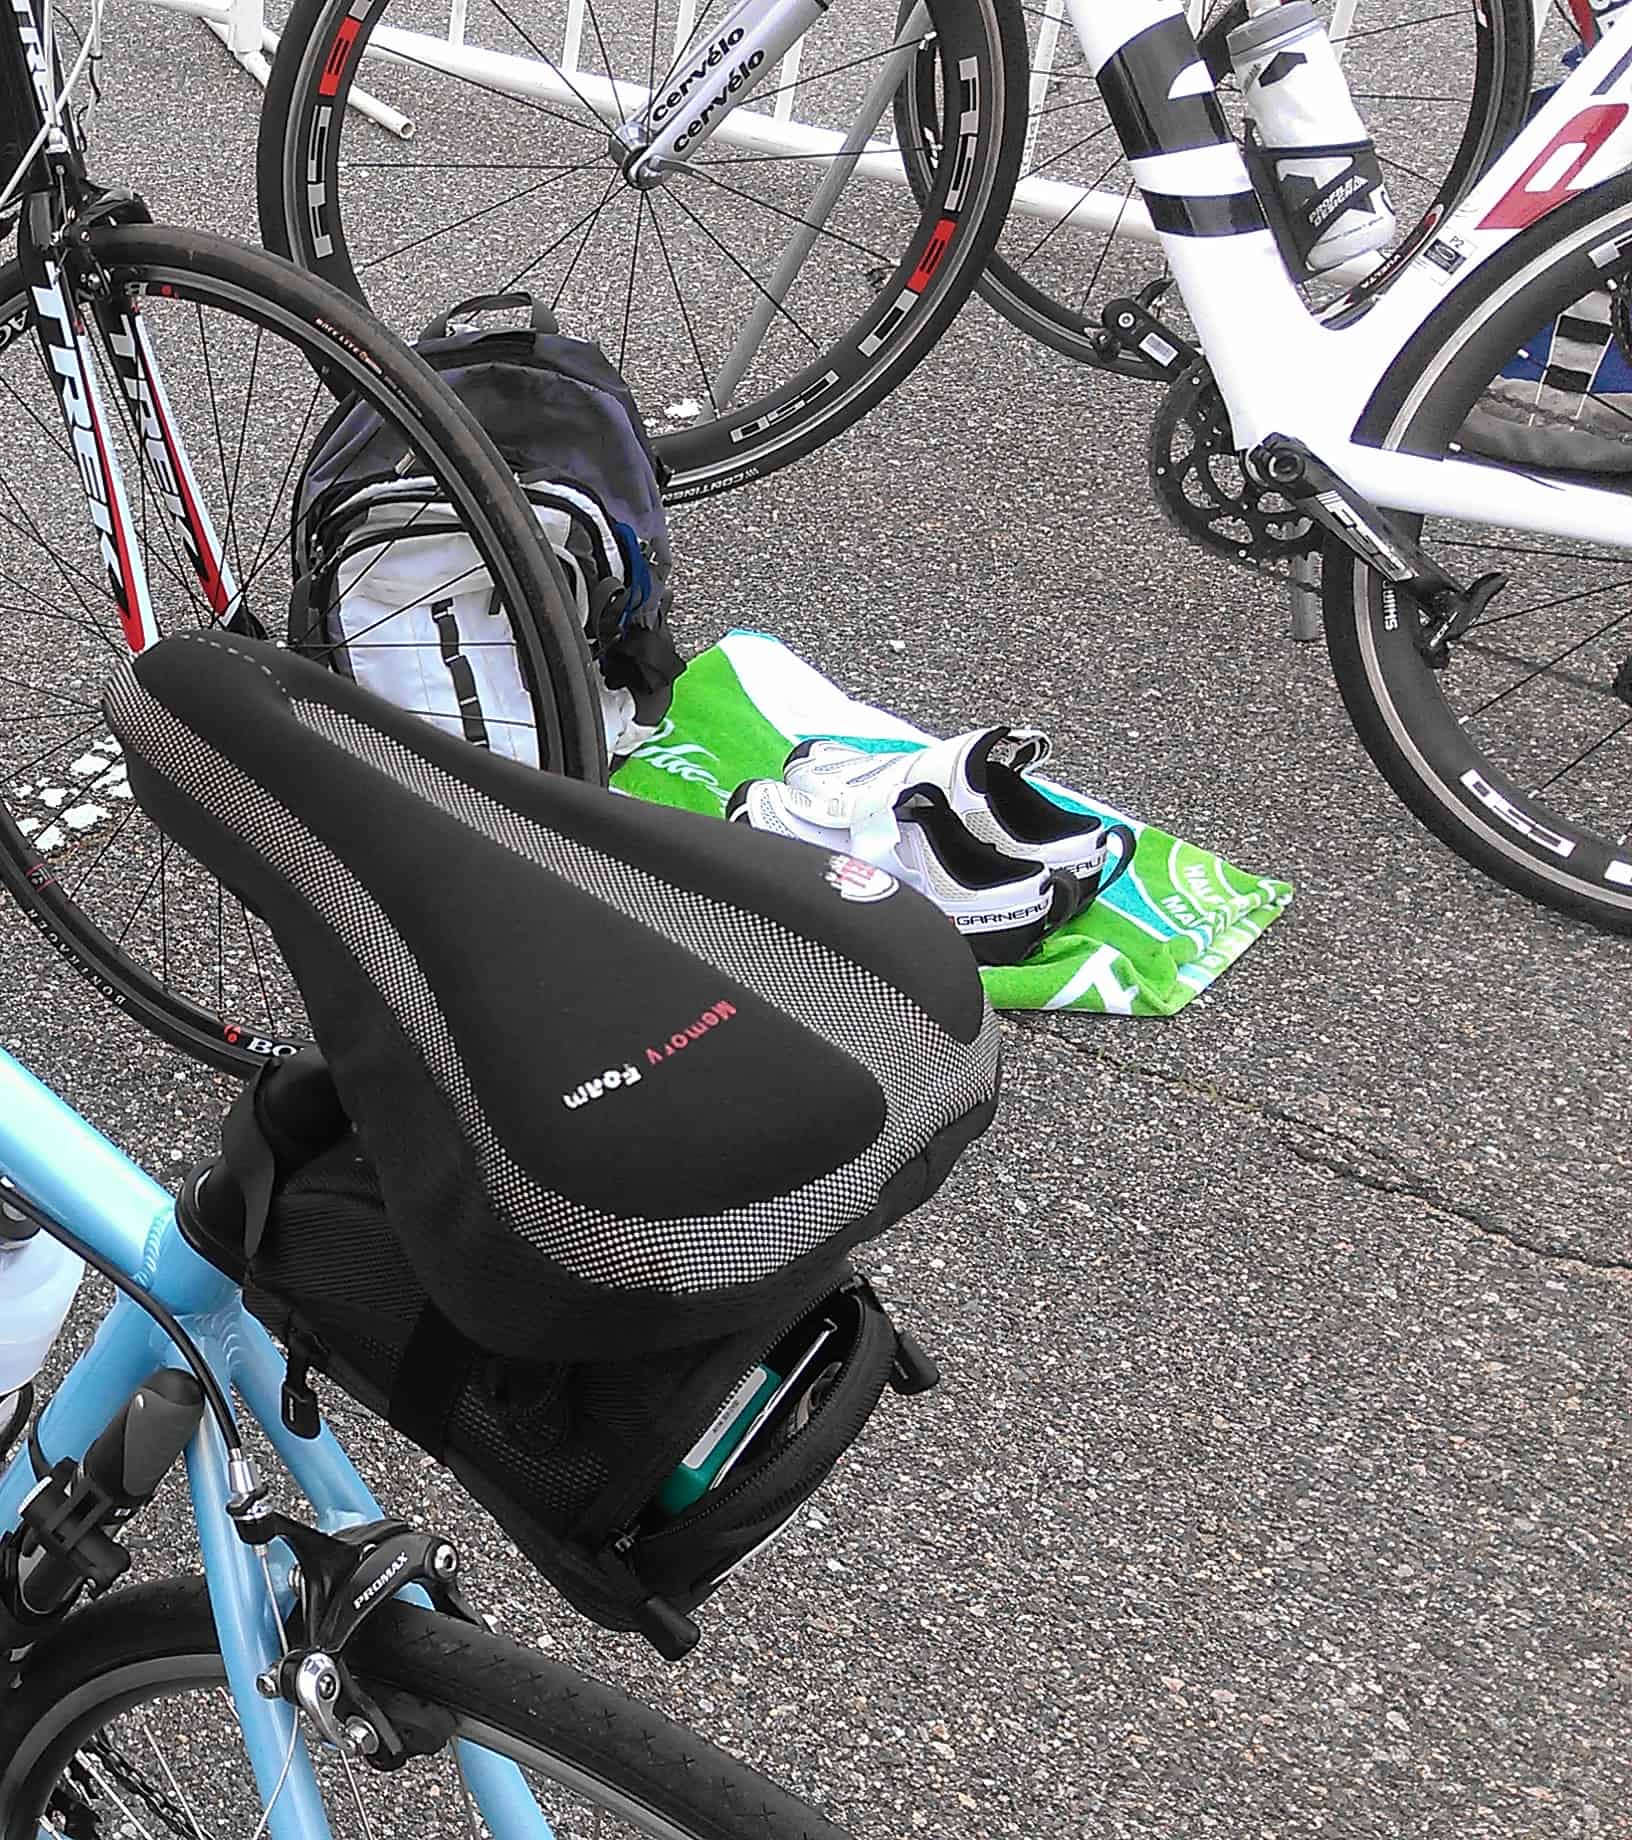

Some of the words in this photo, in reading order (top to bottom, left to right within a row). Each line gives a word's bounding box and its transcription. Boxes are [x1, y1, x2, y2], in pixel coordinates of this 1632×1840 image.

[652, 28, 745, 122] cervélo
[673, 50, 765, 153] cervélo
[32, 261, 125, 590] TREK
[110, 314, 201, 557] TREK
[27, 907, 127, 1005] BONTRAGER
[644, 1000, 737, 1065] Memory
[353, 1551, 409, 1610] PROMAX
